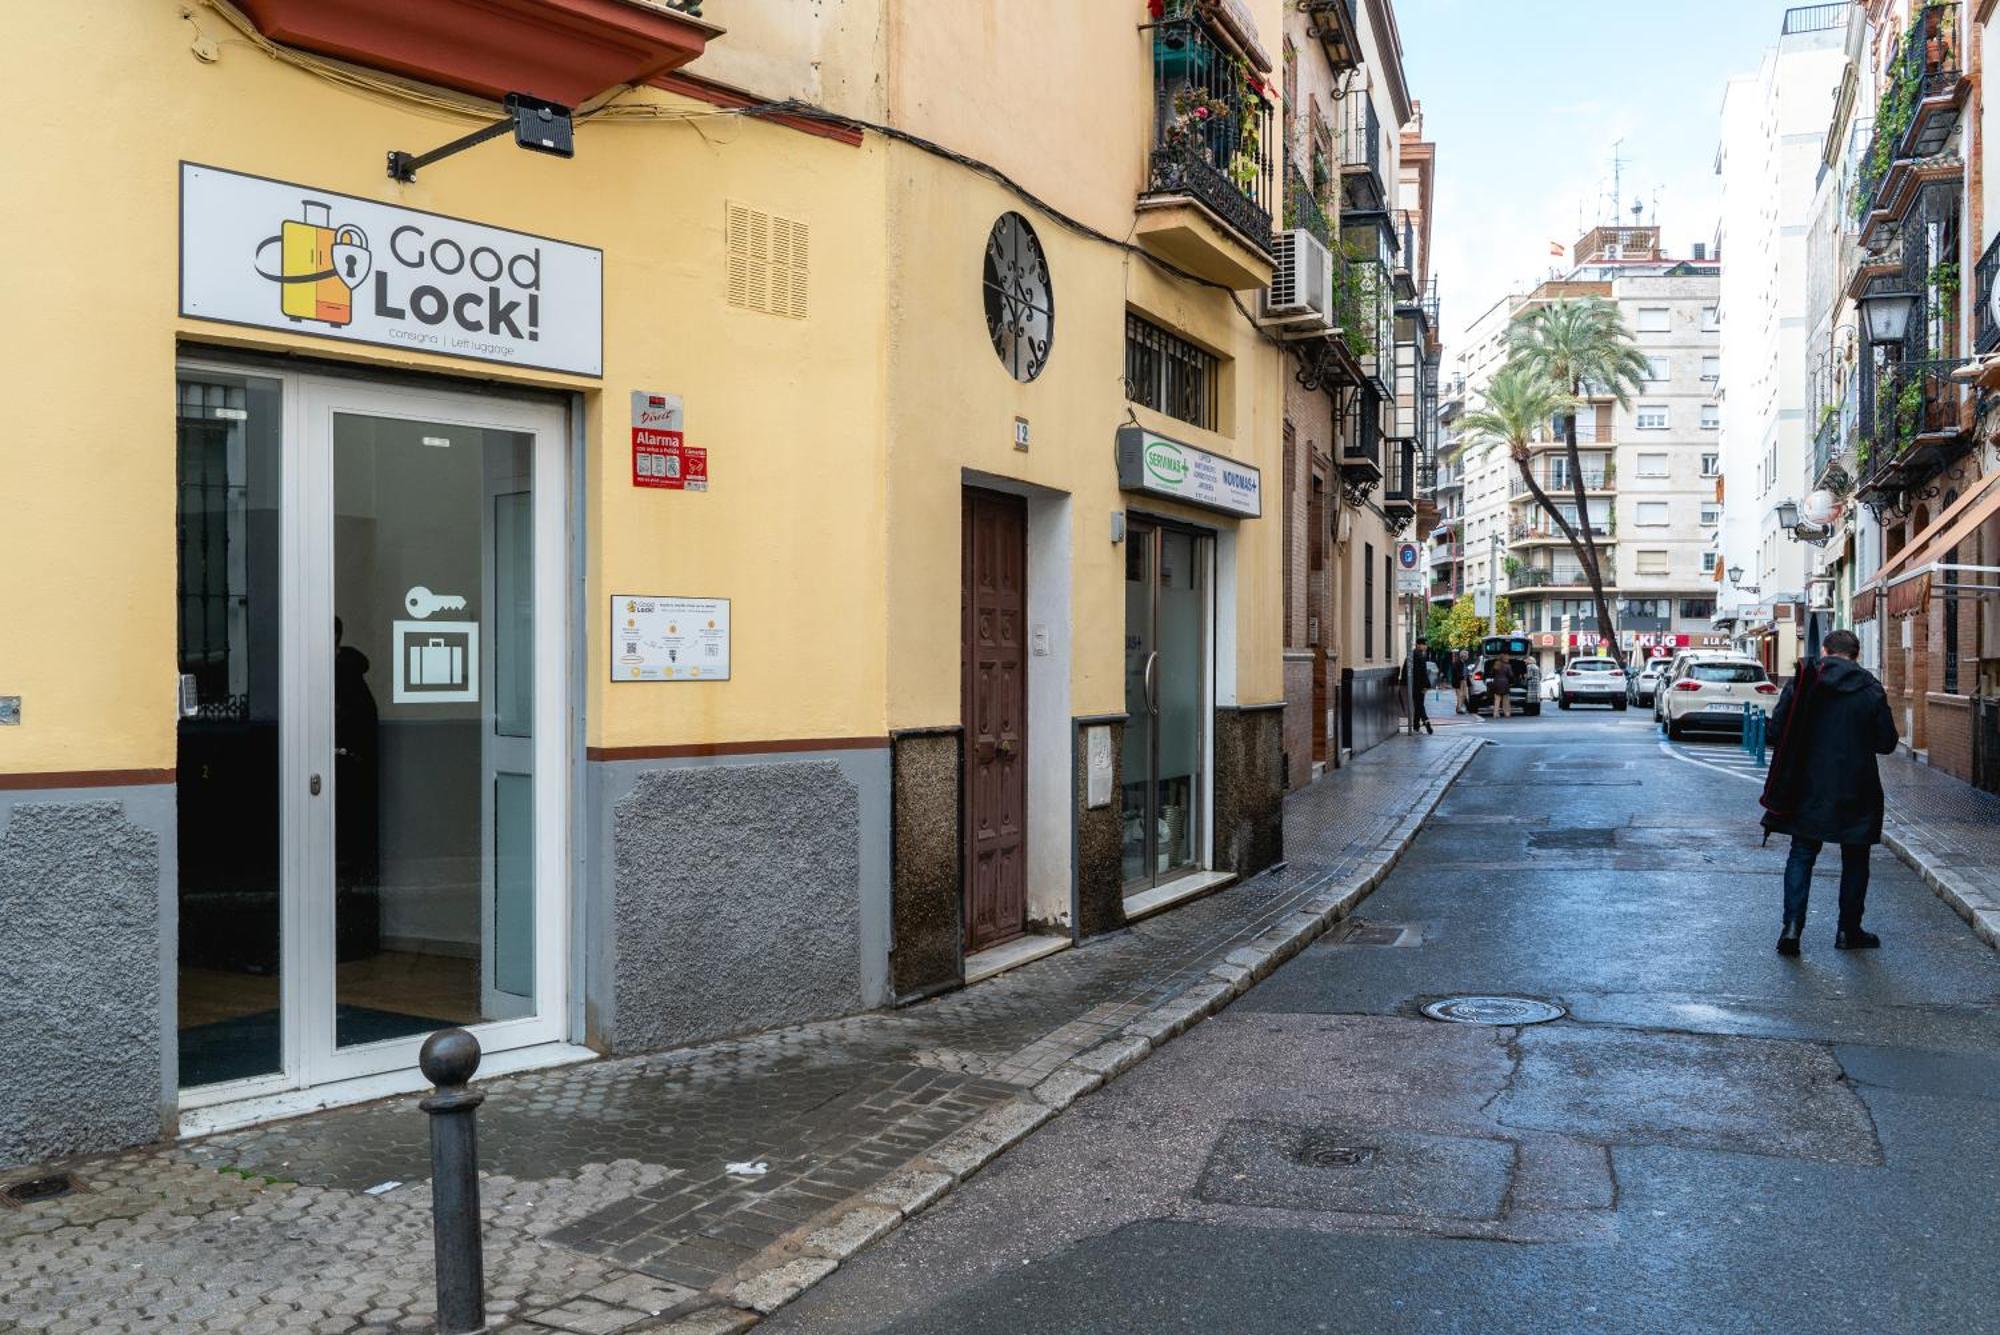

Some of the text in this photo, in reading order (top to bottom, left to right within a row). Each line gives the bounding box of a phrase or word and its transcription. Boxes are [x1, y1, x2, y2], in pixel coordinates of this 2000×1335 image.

[390, 225, 540, 291] Good
[375, 270, 539, 341] Lock!
[388, 328, 438, 344] Consigna
[471, 341, 515, 356] luggage
[637, 431, 680, 447] Alarma
[1016, 423, 1028, 442] 12
